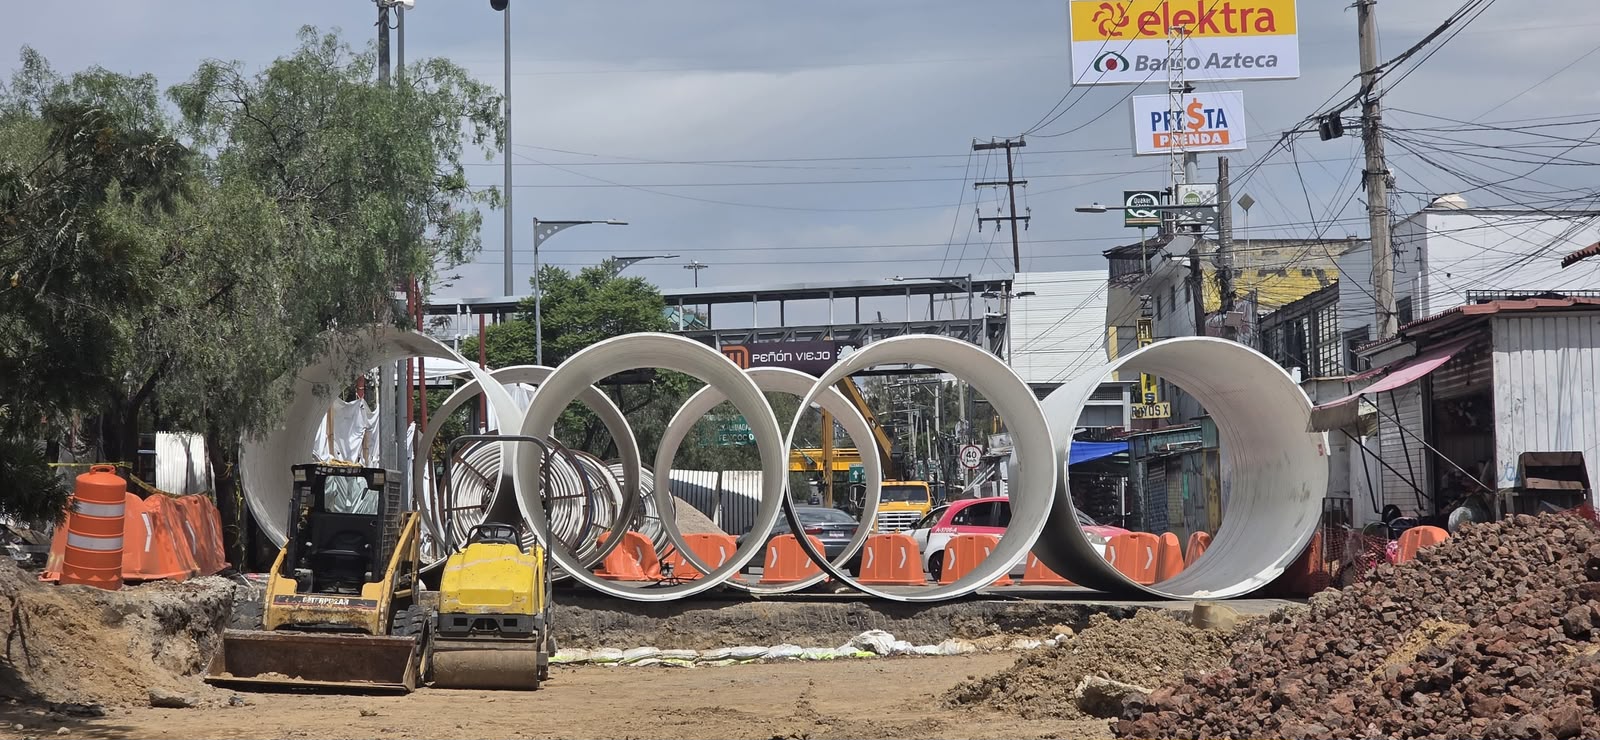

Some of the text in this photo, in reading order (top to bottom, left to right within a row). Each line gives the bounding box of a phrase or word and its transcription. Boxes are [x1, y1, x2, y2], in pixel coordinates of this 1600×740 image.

[1137, 0, 1276, 36] elektra
[1135, 52, 1278, 71] Banco Azteca
[795, 351, 831, 361] VIEJO
[1163, 404, 1169, 416] X
